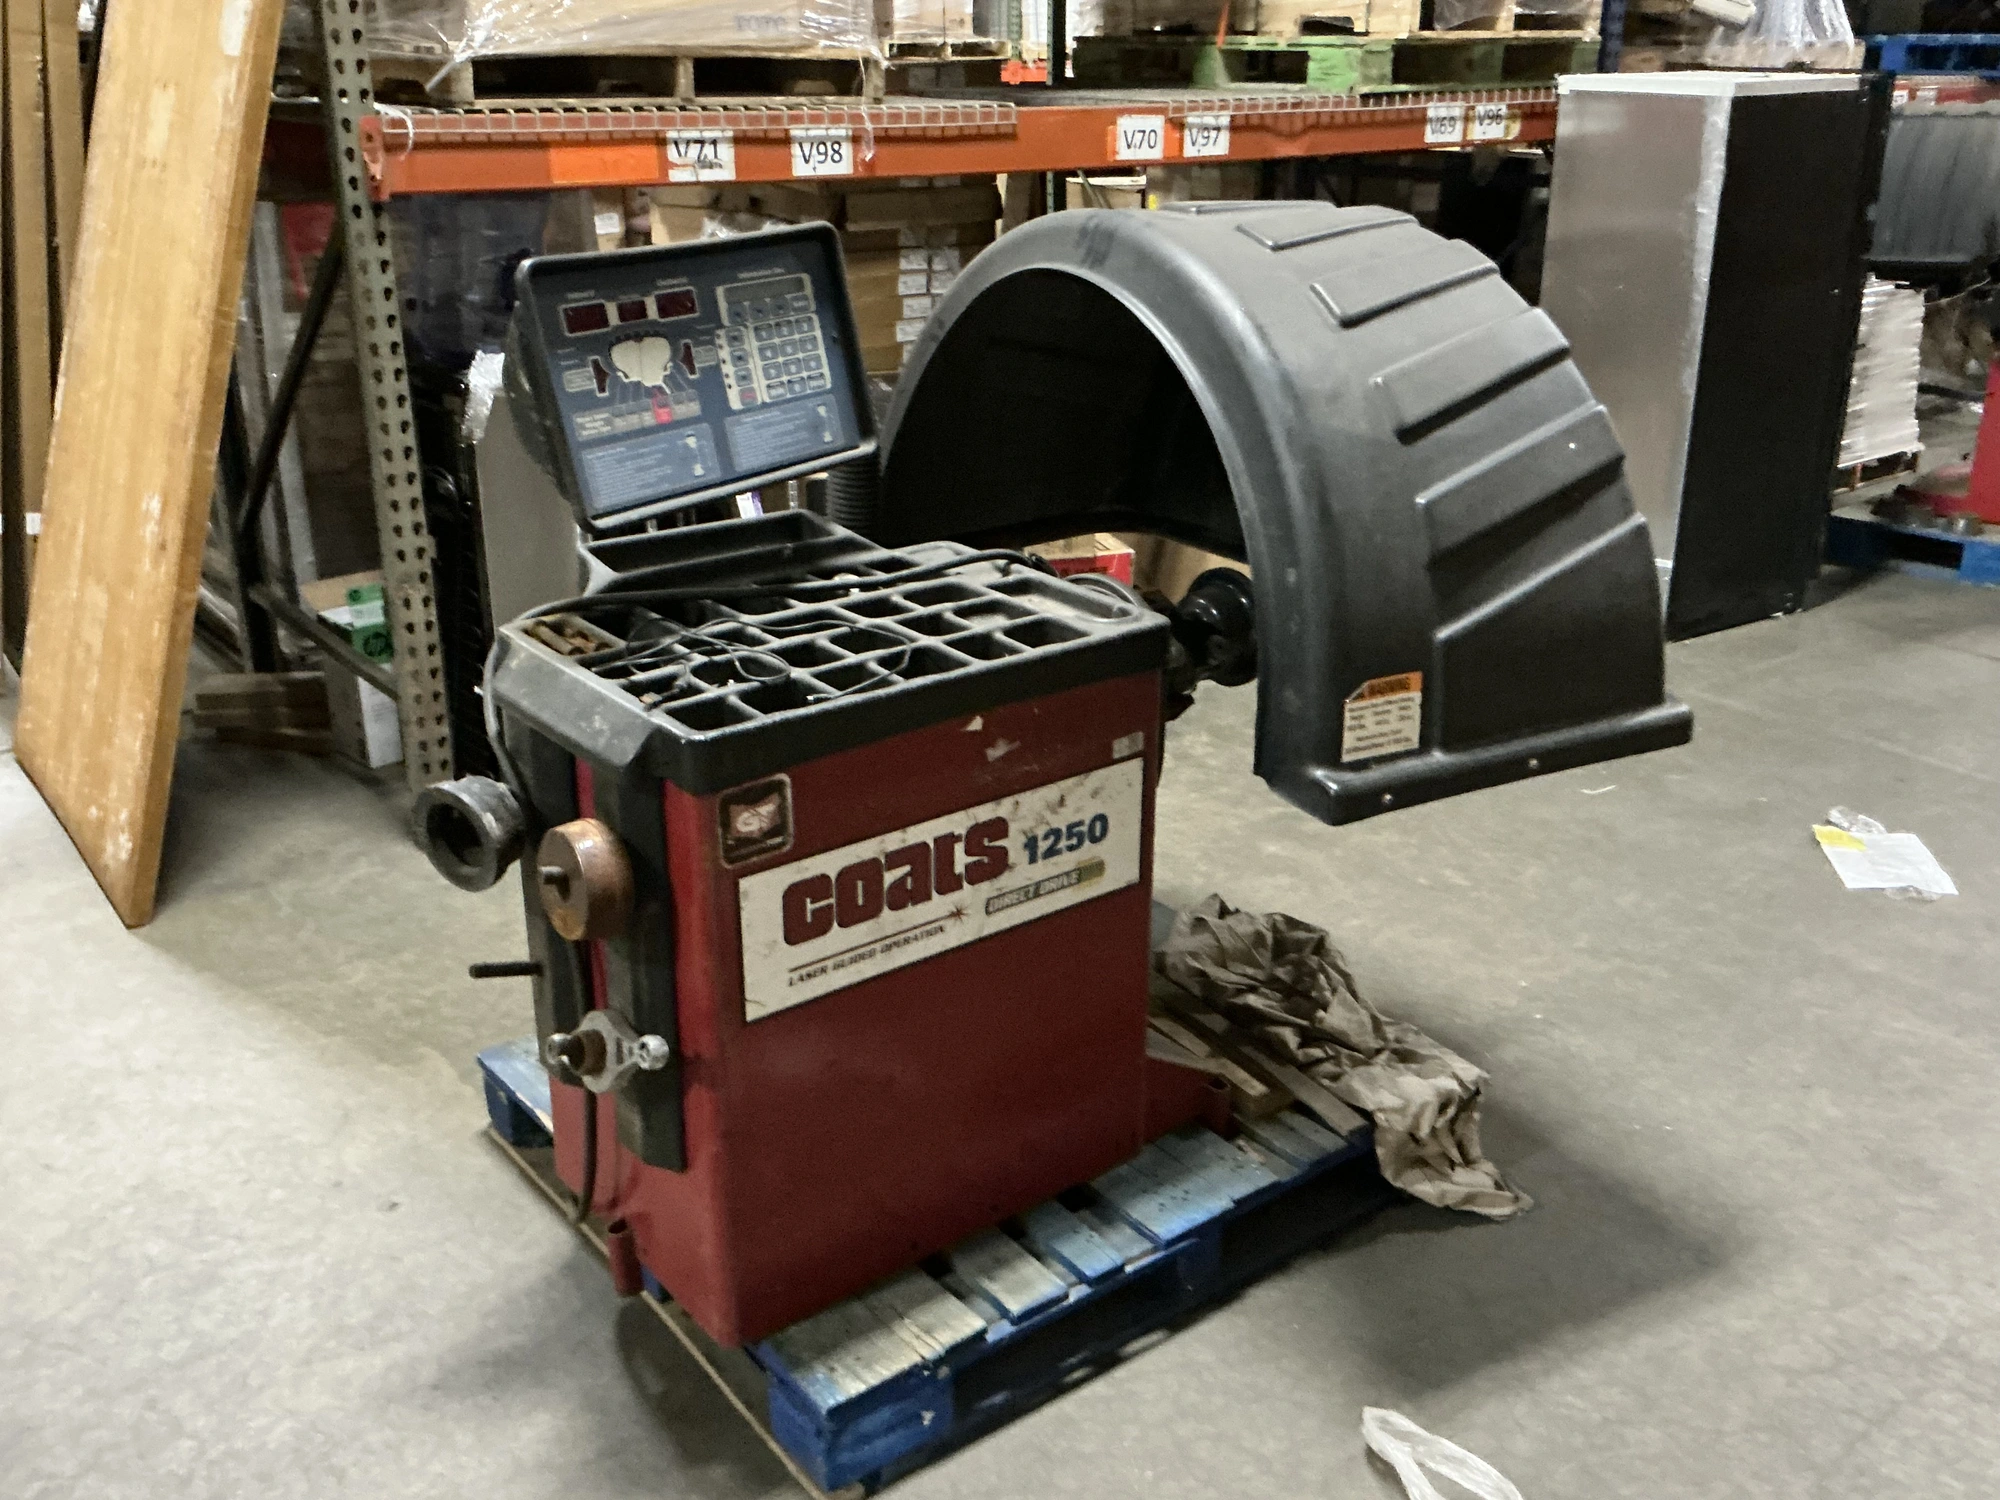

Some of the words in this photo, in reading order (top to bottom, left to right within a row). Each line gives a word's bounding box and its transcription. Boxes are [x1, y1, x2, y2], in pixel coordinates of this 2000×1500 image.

[1429, 116, 1457, 135] V69
[1478, 108, 1503, 127] V96
[1123, 129, 1158, 150] V70
[1189, 126, 1221, 147] V97
[673, 138, 720, 162] V71
[799, 140, 843, 165] V98
[1023, 813, 1109, 865] 1250
